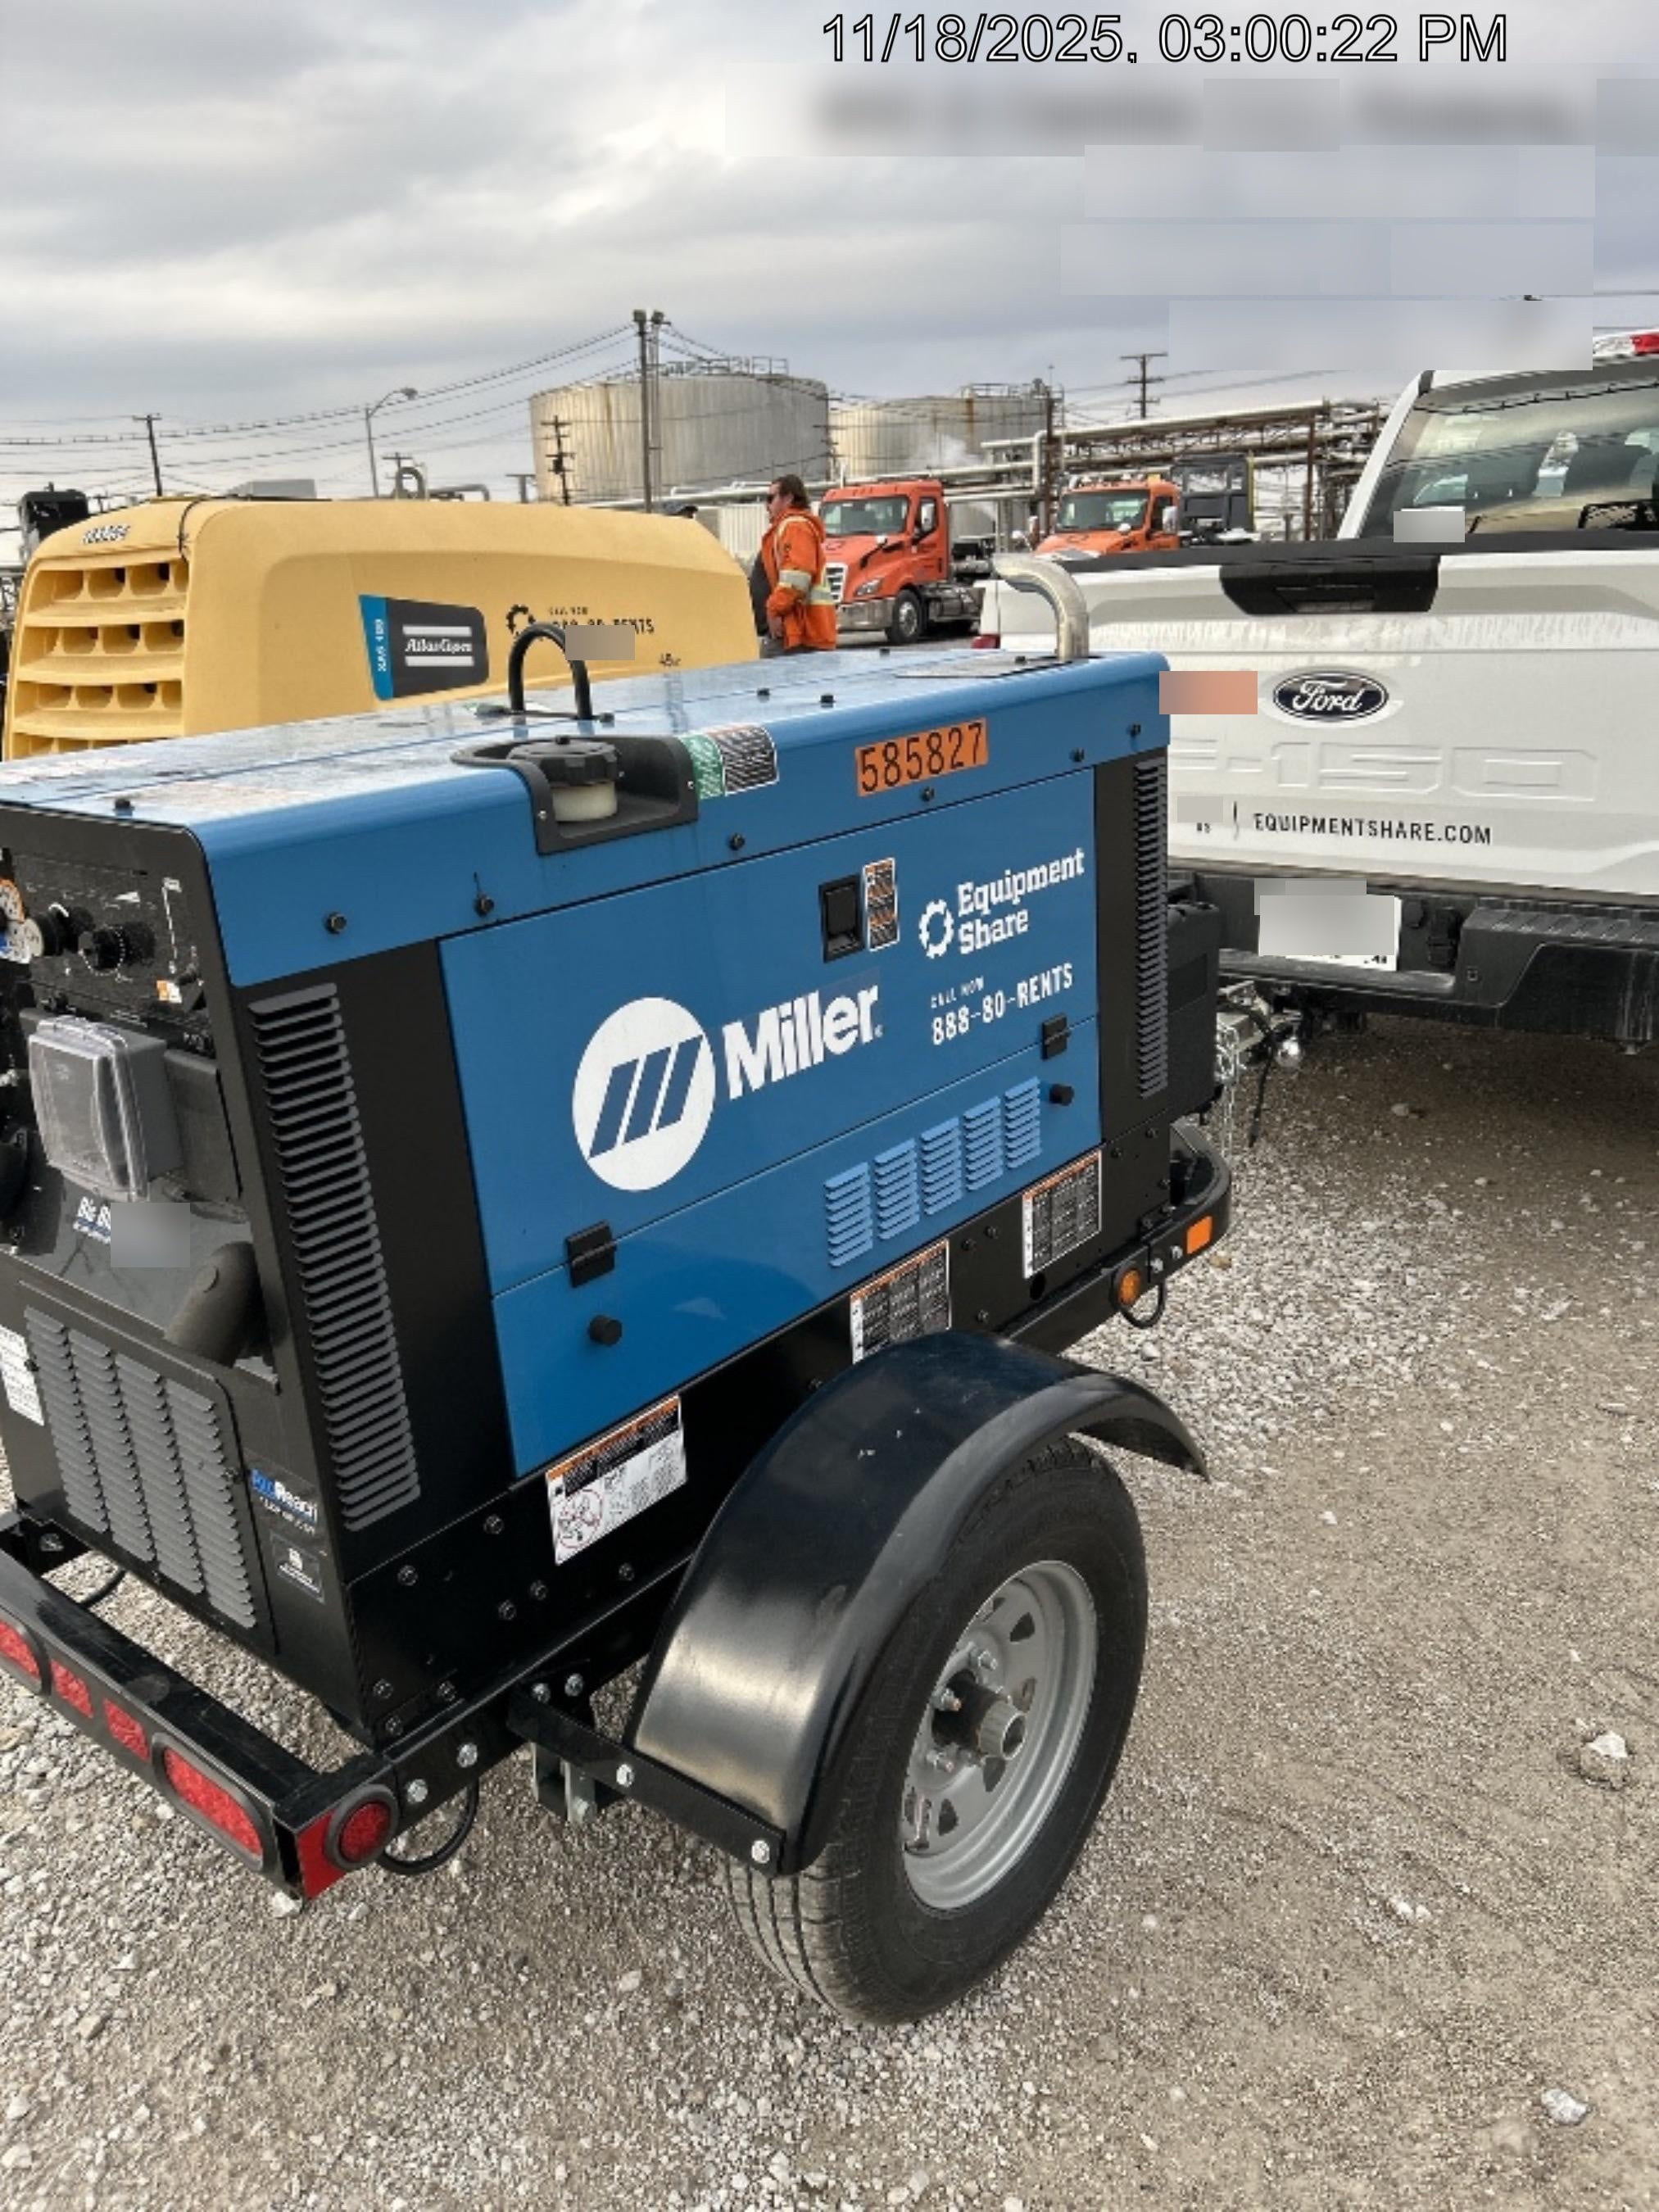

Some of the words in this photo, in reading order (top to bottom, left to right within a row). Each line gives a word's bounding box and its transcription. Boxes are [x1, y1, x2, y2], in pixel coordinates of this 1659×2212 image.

[1292, 680, 1366, 712] Ford
[860, 723, 983, 792] 585827
[1253, 812, 1492, 845] EQUIPMENTSHARE.COM
[957, 847, 1086, 917] Equipment
[958, 909, 1030, 955] Share
[932, 963, 1073, 1045] 888-80-RENTS
